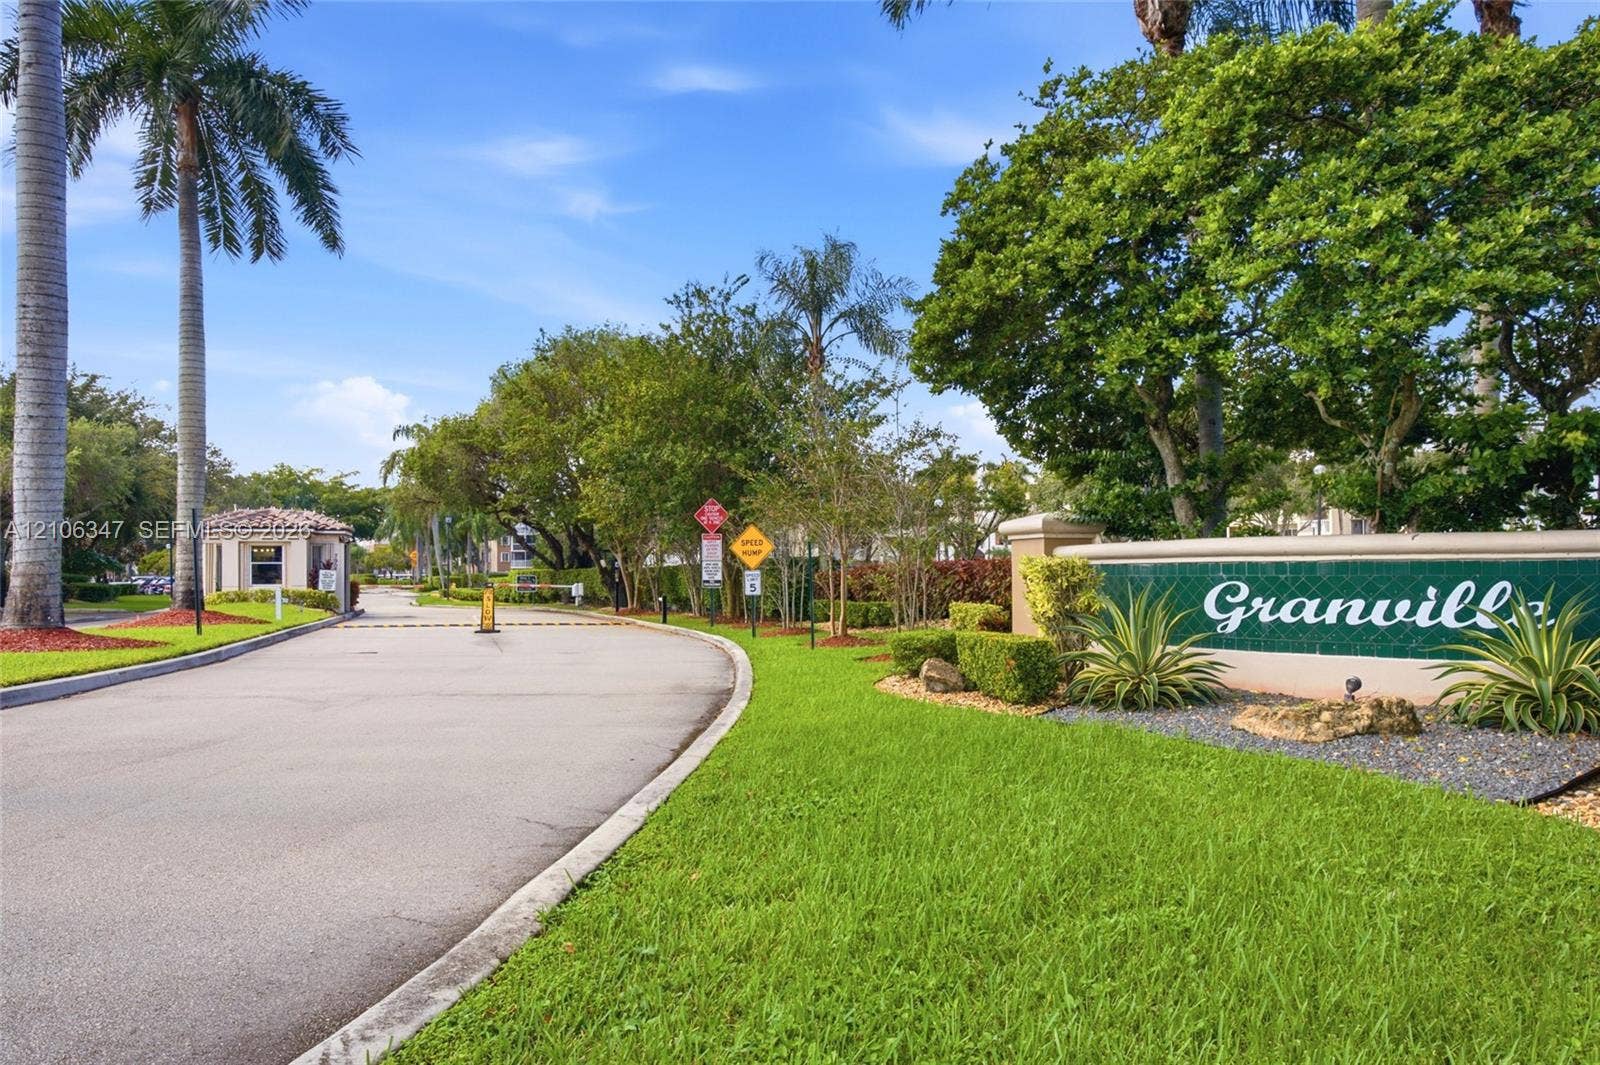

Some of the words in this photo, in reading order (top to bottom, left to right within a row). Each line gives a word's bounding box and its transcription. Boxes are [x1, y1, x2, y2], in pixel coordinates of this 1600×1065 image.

[740, 539, 764, 547] SPEED
[741, 549, 763, 557] HUMP
[749, 583, 757, 593] 5
[483, 595, 492, 622] SLOW
